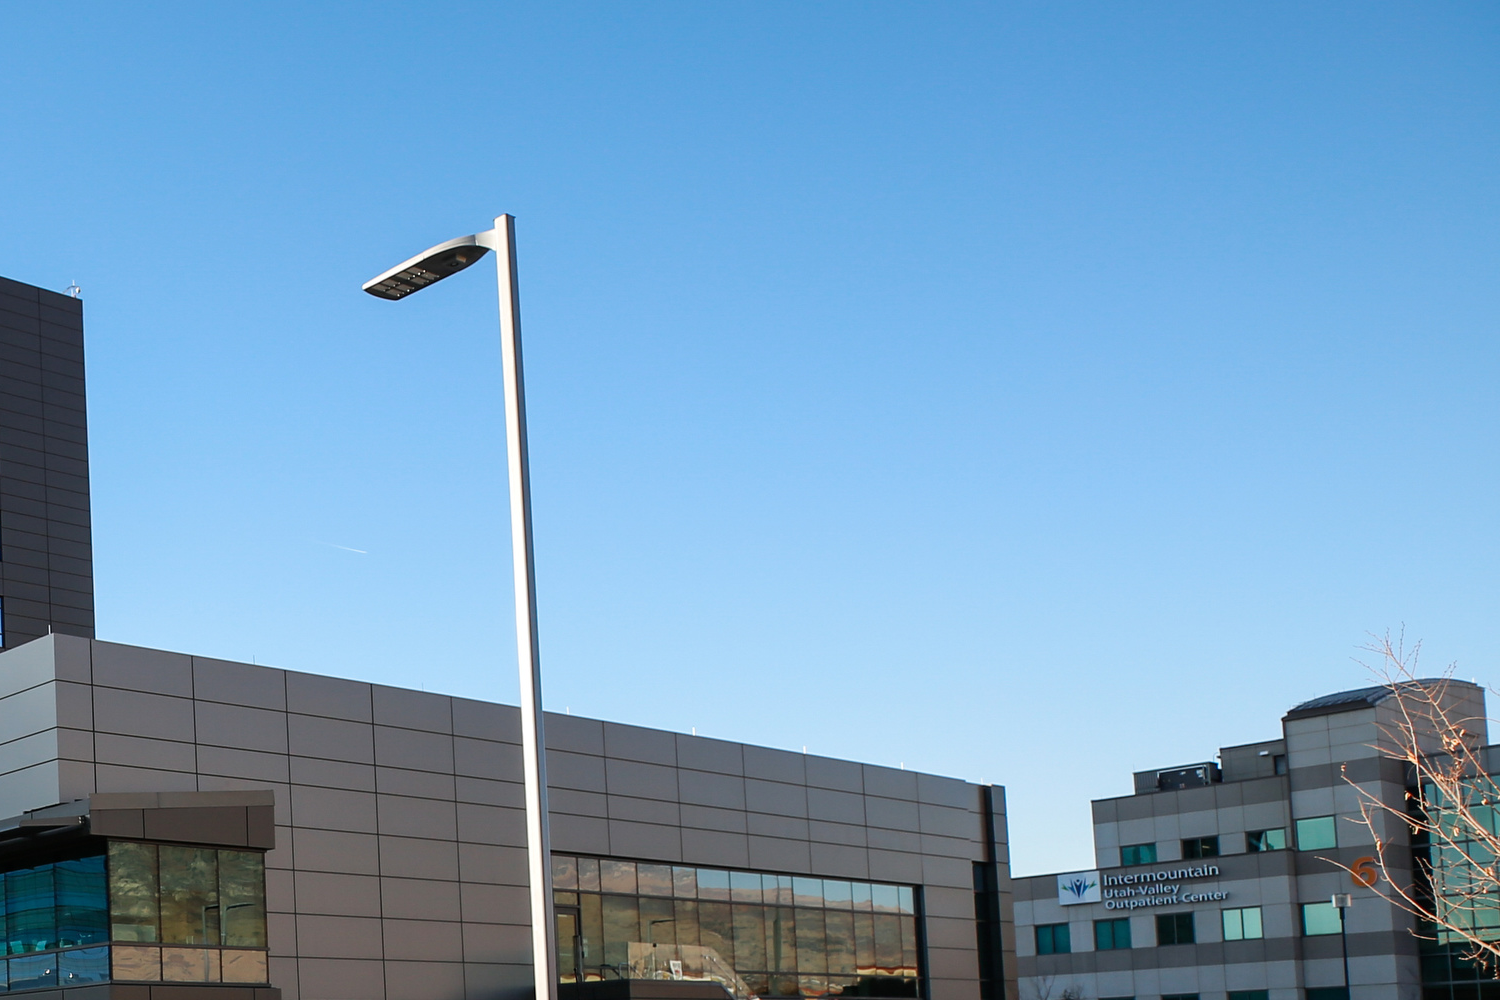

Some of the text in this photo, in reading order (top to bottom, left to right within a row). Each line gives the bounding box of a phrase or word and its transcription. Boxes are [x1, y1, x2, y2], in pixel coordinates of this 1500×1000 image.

[1103, 864, 1219, 886] Intermountain
[1352, 856, 1377, 887] 6
[1104, 883, 1180, 899] Utah Valley
[1105, 891, 1228, 910] Outpatient Center
